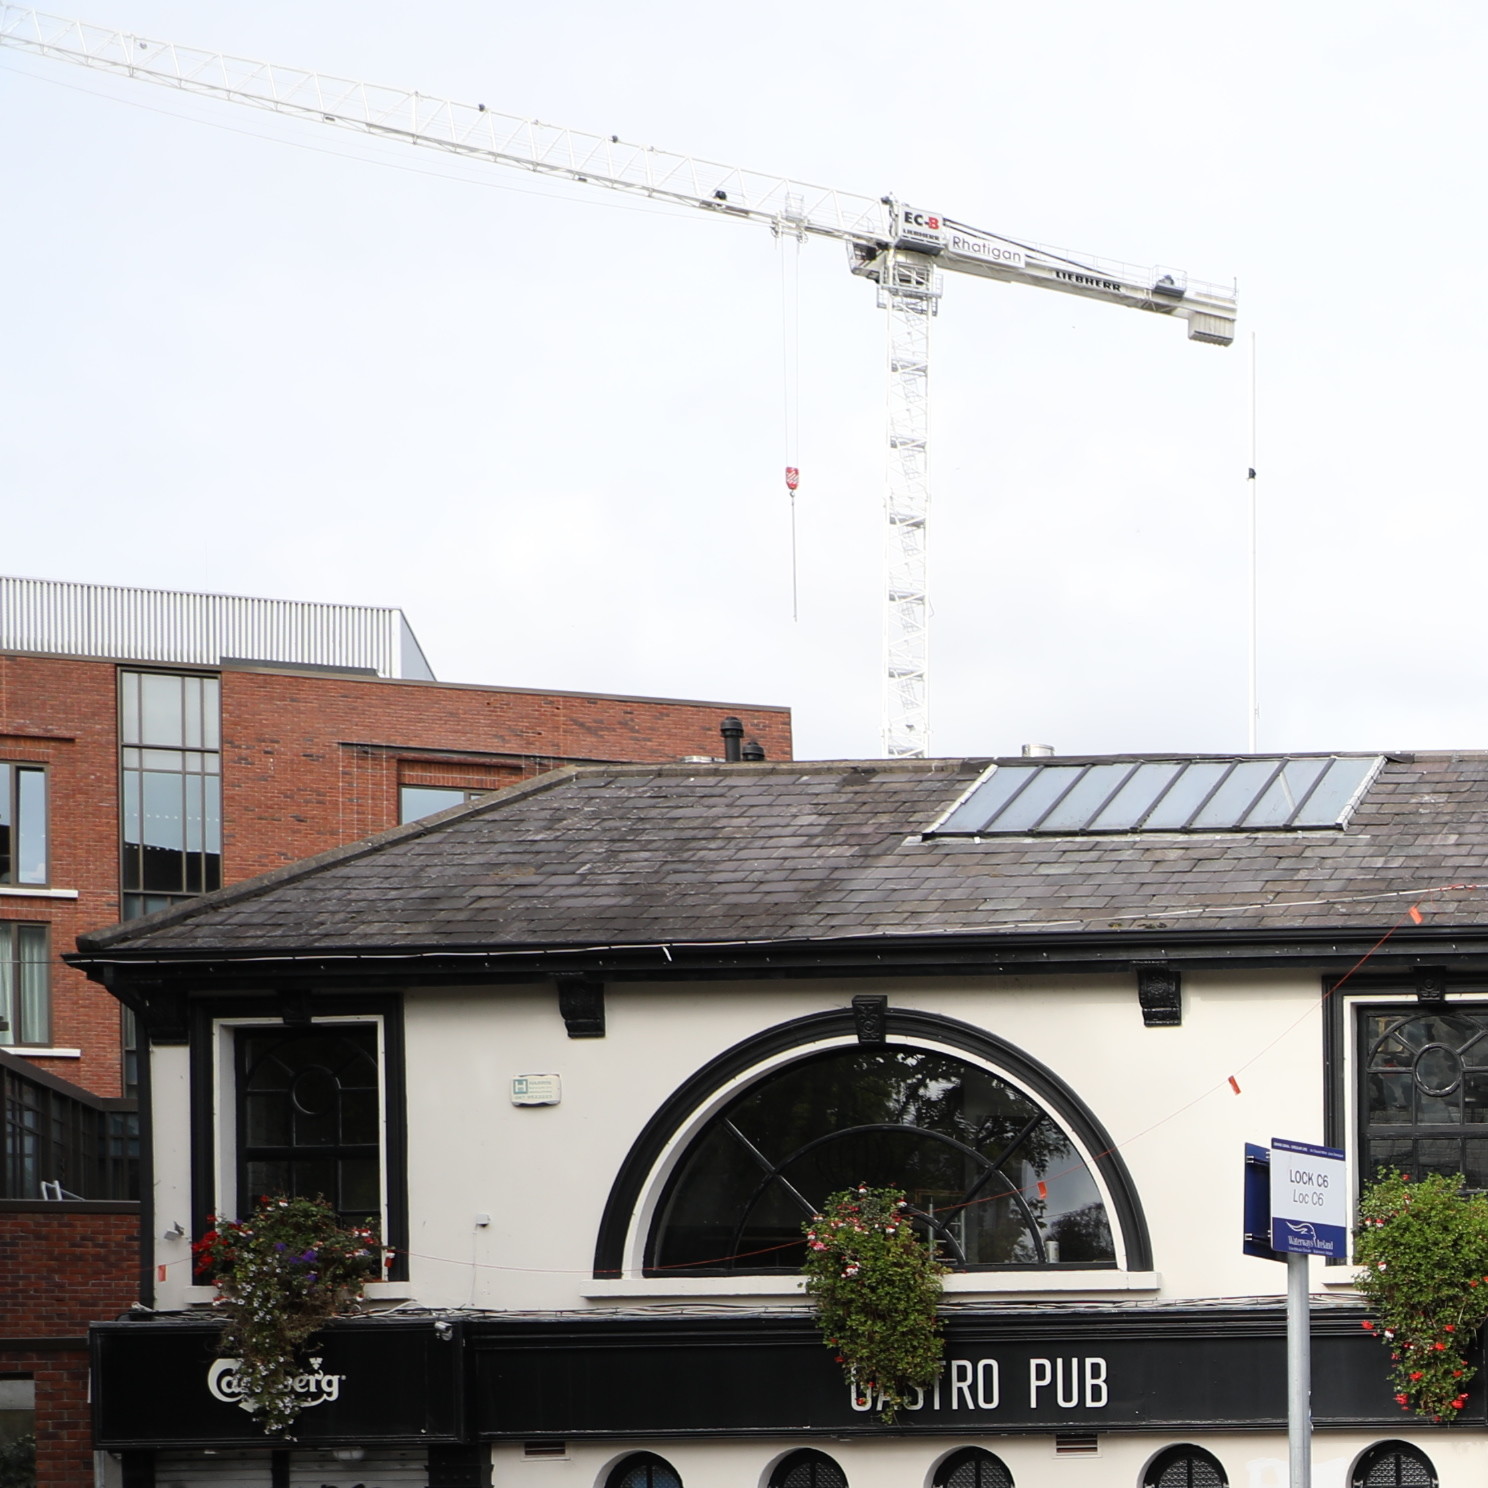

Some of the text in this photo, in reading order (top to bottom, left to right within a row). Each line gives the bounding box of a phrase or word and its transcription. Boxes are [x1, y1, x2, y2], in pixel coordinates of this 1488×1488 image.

[904, 211, 939, 229] EC-B
[952, 236, 1021, 262] Rhatigan
[1055, 271, 1122, 292] LIEBHERR
[1289, 1169, 1329, 1188] LOCK C6
[1293, 1189, 1324, 1206] Loc C6
[1288, 1235, 1314, 1248] Waterways
[208, 1358, 344, 1413] Caerg
[1029, 1357, 1109, 1409] PUB
